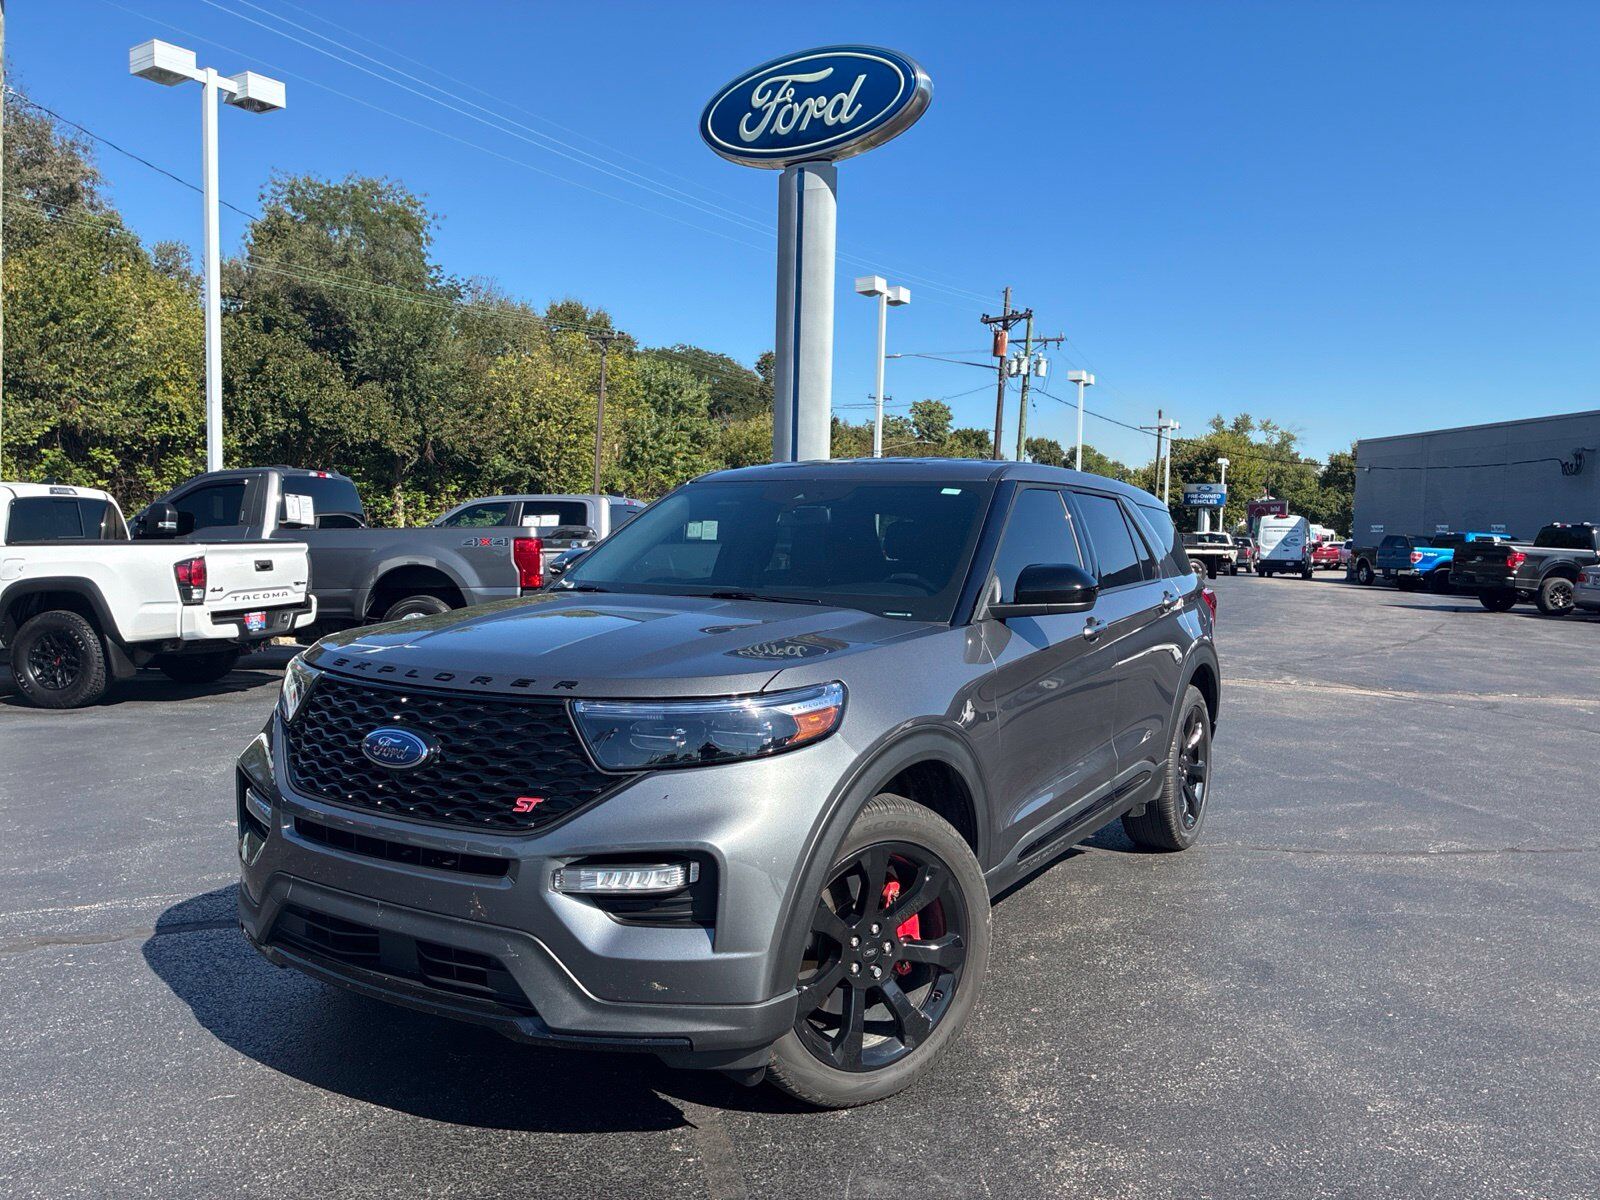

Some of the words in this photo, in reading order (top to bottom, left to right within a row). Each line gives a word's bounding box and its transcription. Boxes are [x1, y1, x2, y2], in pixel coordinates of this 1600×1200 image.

[739, 67, 867, 142] Ford
[462, 537, 509, 548] 4X4
[231, 591, 288, 602] TACOMA
[333, 657, 579, 690] EXPLORER
[373, 736, 409, 760] Ford
[512, 796, 544, 813] ST
